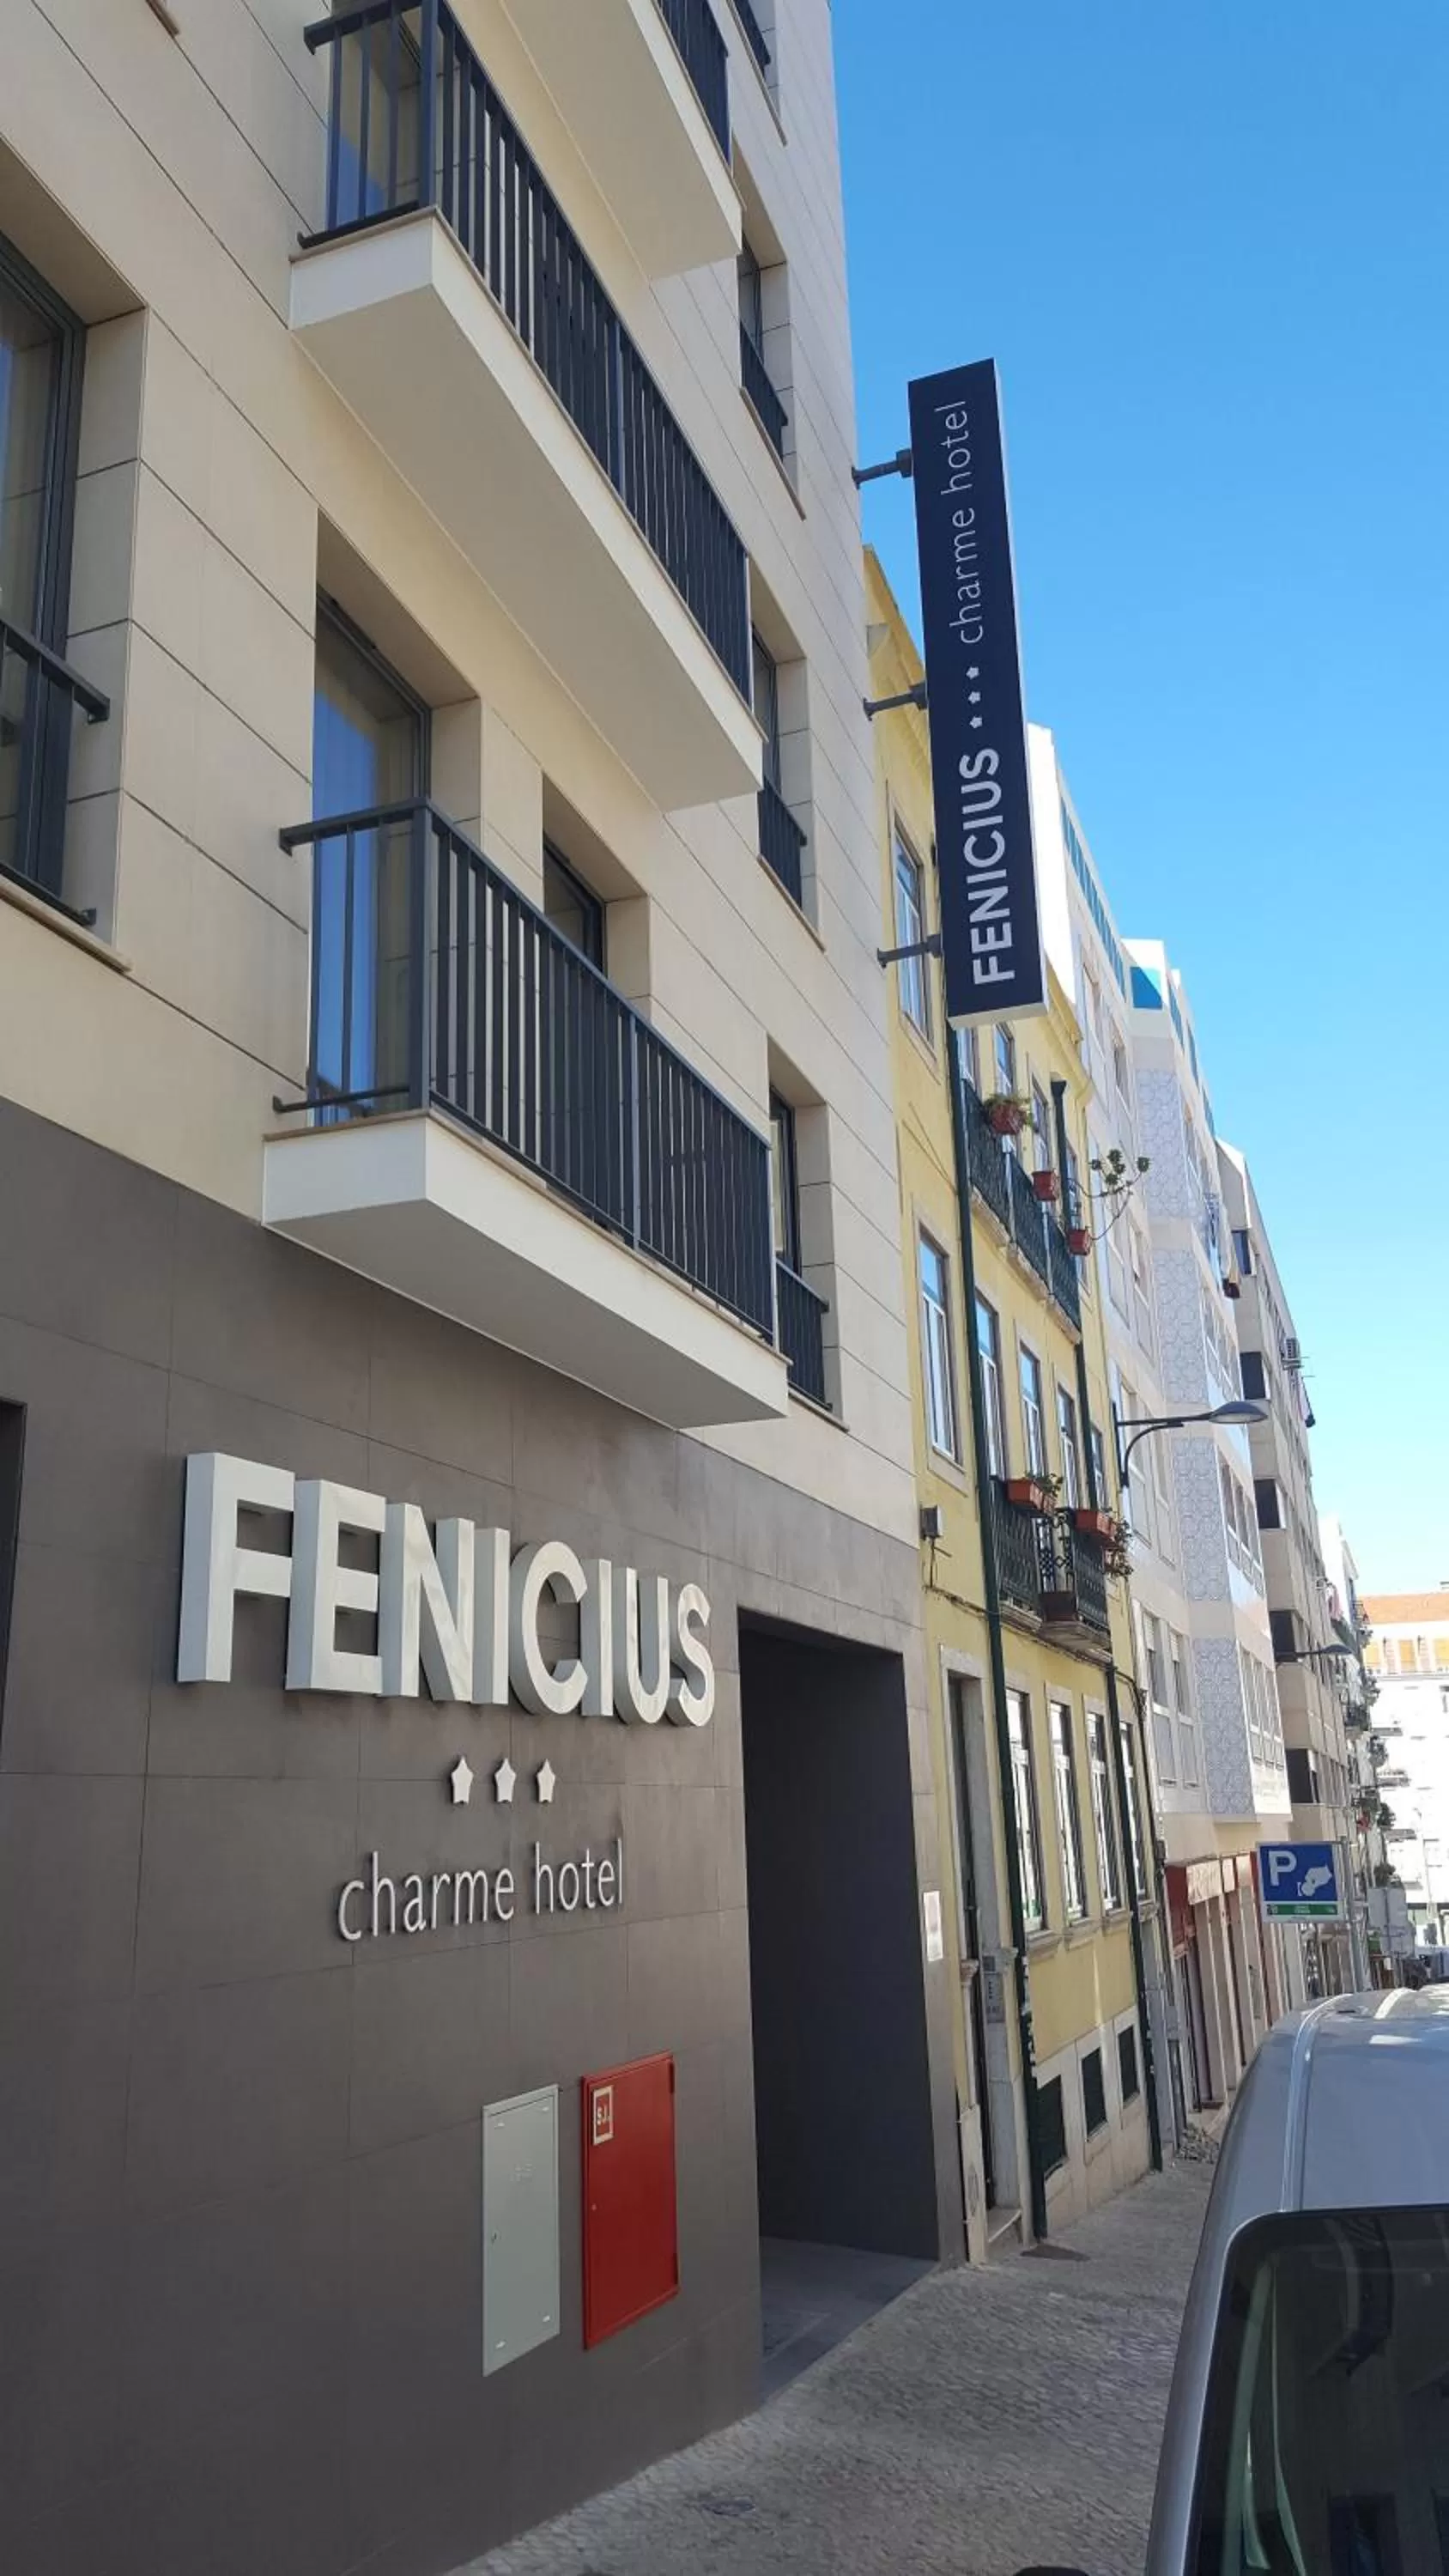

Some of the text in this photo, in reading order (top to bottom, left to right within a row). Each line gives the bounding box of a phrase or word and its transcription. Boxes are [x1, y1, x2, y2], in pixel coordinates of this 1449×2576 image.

[935, 400, 1016, 985] FENICIUS charme hotel
[178, 1452, 715, 1726] FENICIUS
[336, 1838, 624, 1941] charme hotel
[1269, 1850, 1297, 1886] P
